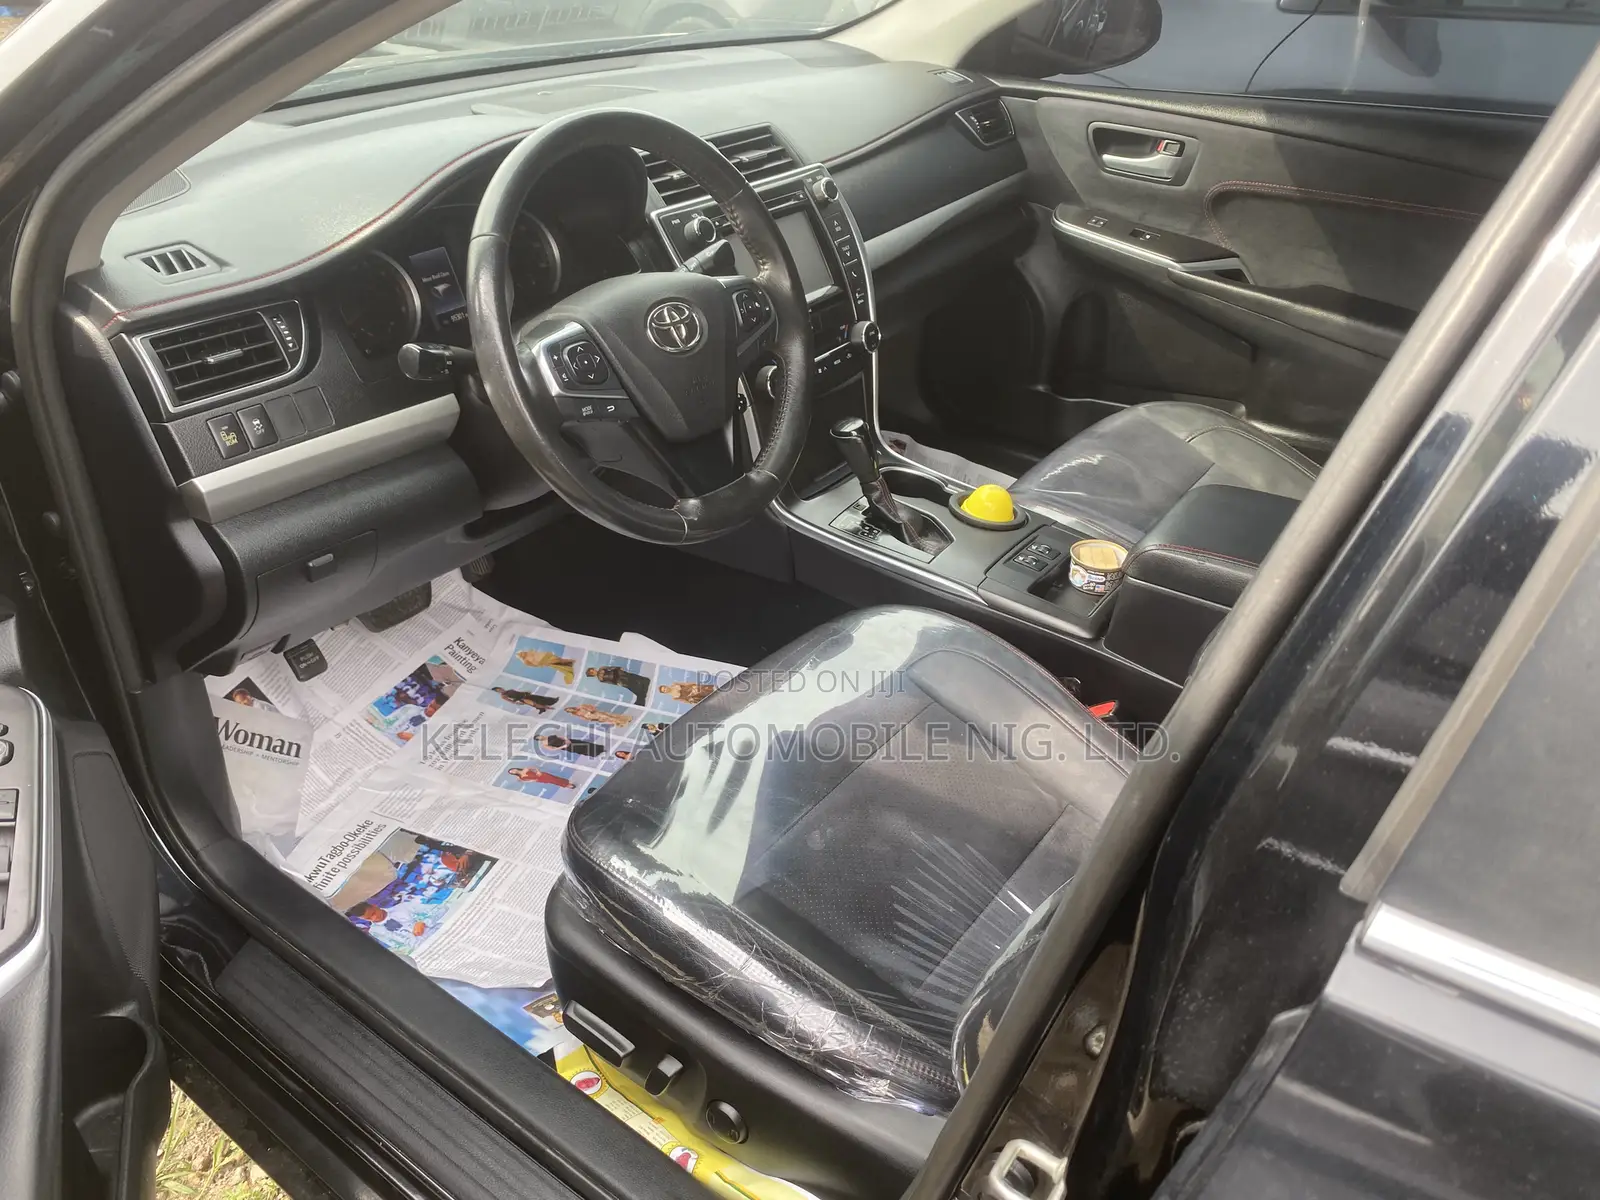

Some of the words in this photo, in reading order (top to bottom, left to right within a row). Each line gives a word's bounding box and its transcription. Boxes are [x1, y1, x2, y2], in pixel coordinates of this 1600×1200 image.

[444, 644, 477, 674] Painting
[453, 637, 486, 665] Kanyeya
[214, 716, 302, 758] Woman
[222, 743, 255, 756] EADERSHIP
[261, 754, 300, 766] MENTORSHIP
[337, 823, 387, 869] possibilities
